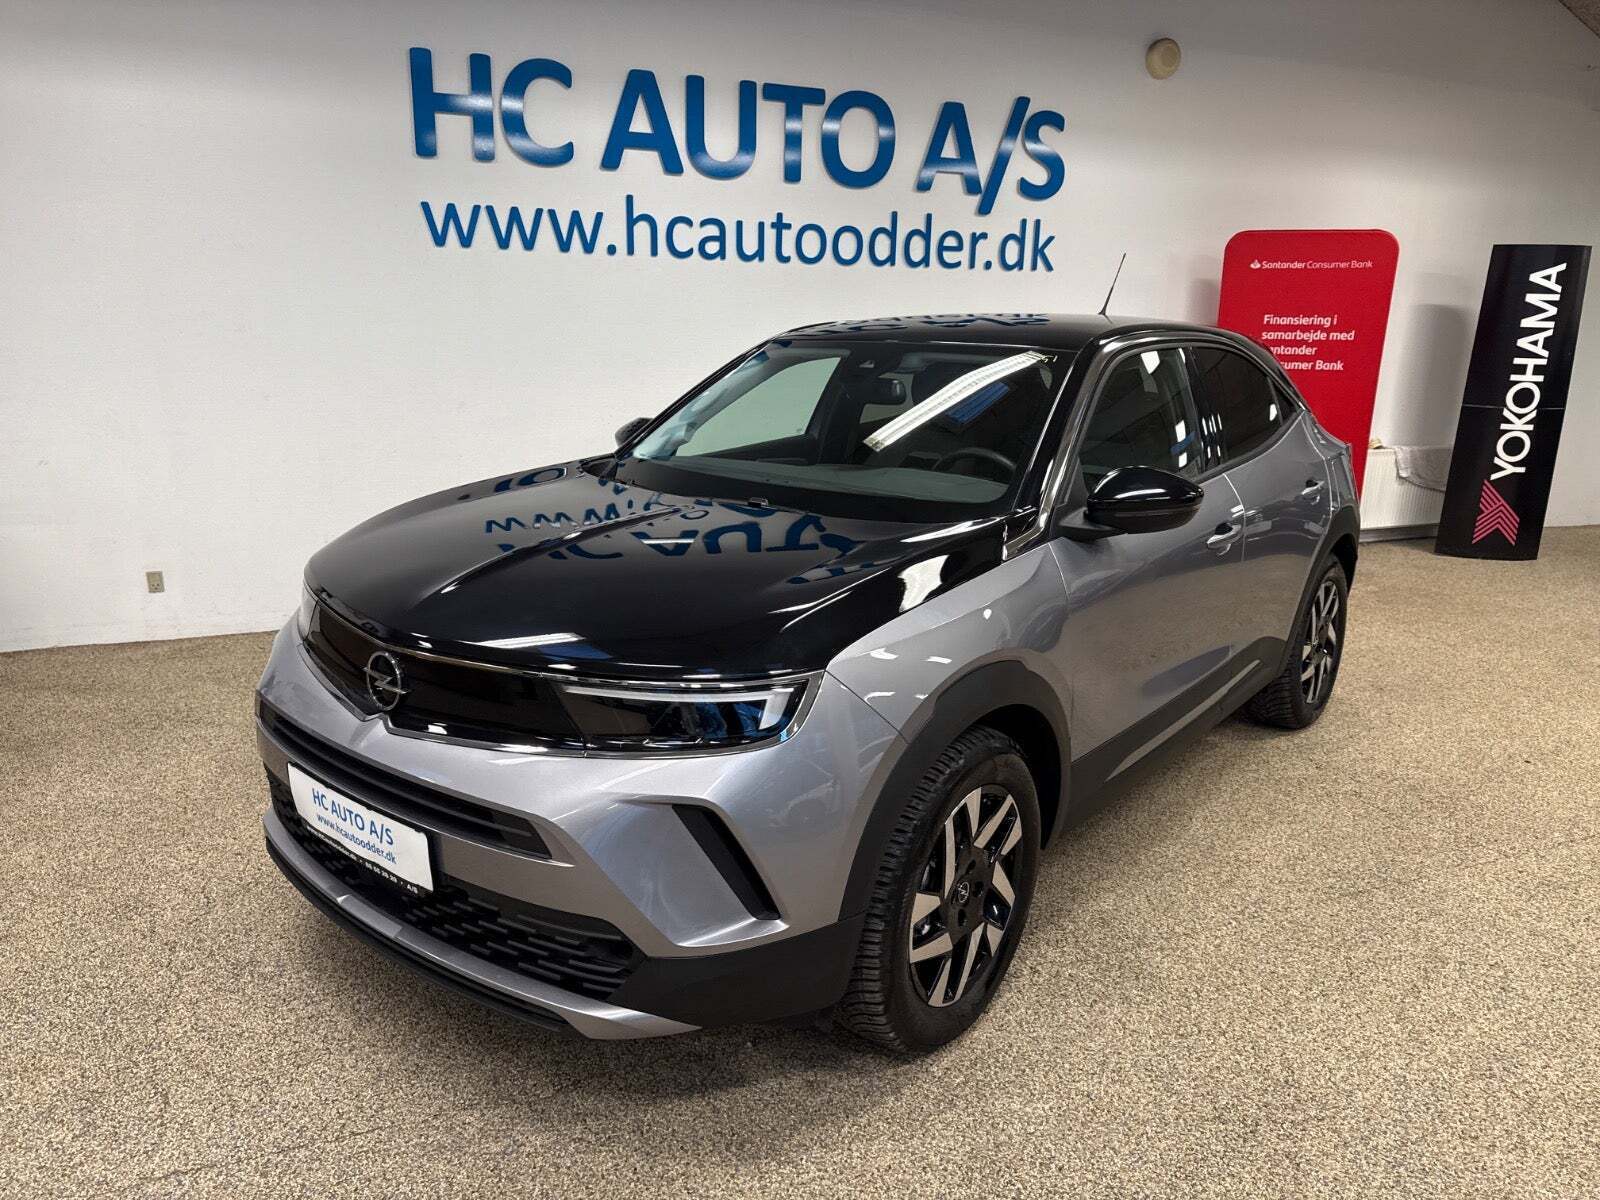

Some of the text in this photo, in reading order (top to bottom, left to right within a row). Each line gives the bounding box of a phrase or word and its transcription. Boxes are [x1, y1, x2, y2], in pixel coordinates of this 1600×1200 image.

[409, 47, 1066, 216] HC AUTO A/S
[420, 194, 1055, 271] www.hcautoodder.dk
[1262, 260, 1373, 269] Santander Consumer Bank
[1262, 329, 1355, 342] samarbejde med
[1263, 314, 1338, 328] Finansiering i
[1269, 345, 1318, 355] ntander
[1315, 360, 1344, 371] Bank
[1490, 262, 1567, 481] YOKOHAMA
[312, 788, 328, 811] HC
[331, 800, 365, 831] AUTO
[369, 820, 394, 846] A/S
[317, 813, 396, 865] www.hcautoodder.dk
